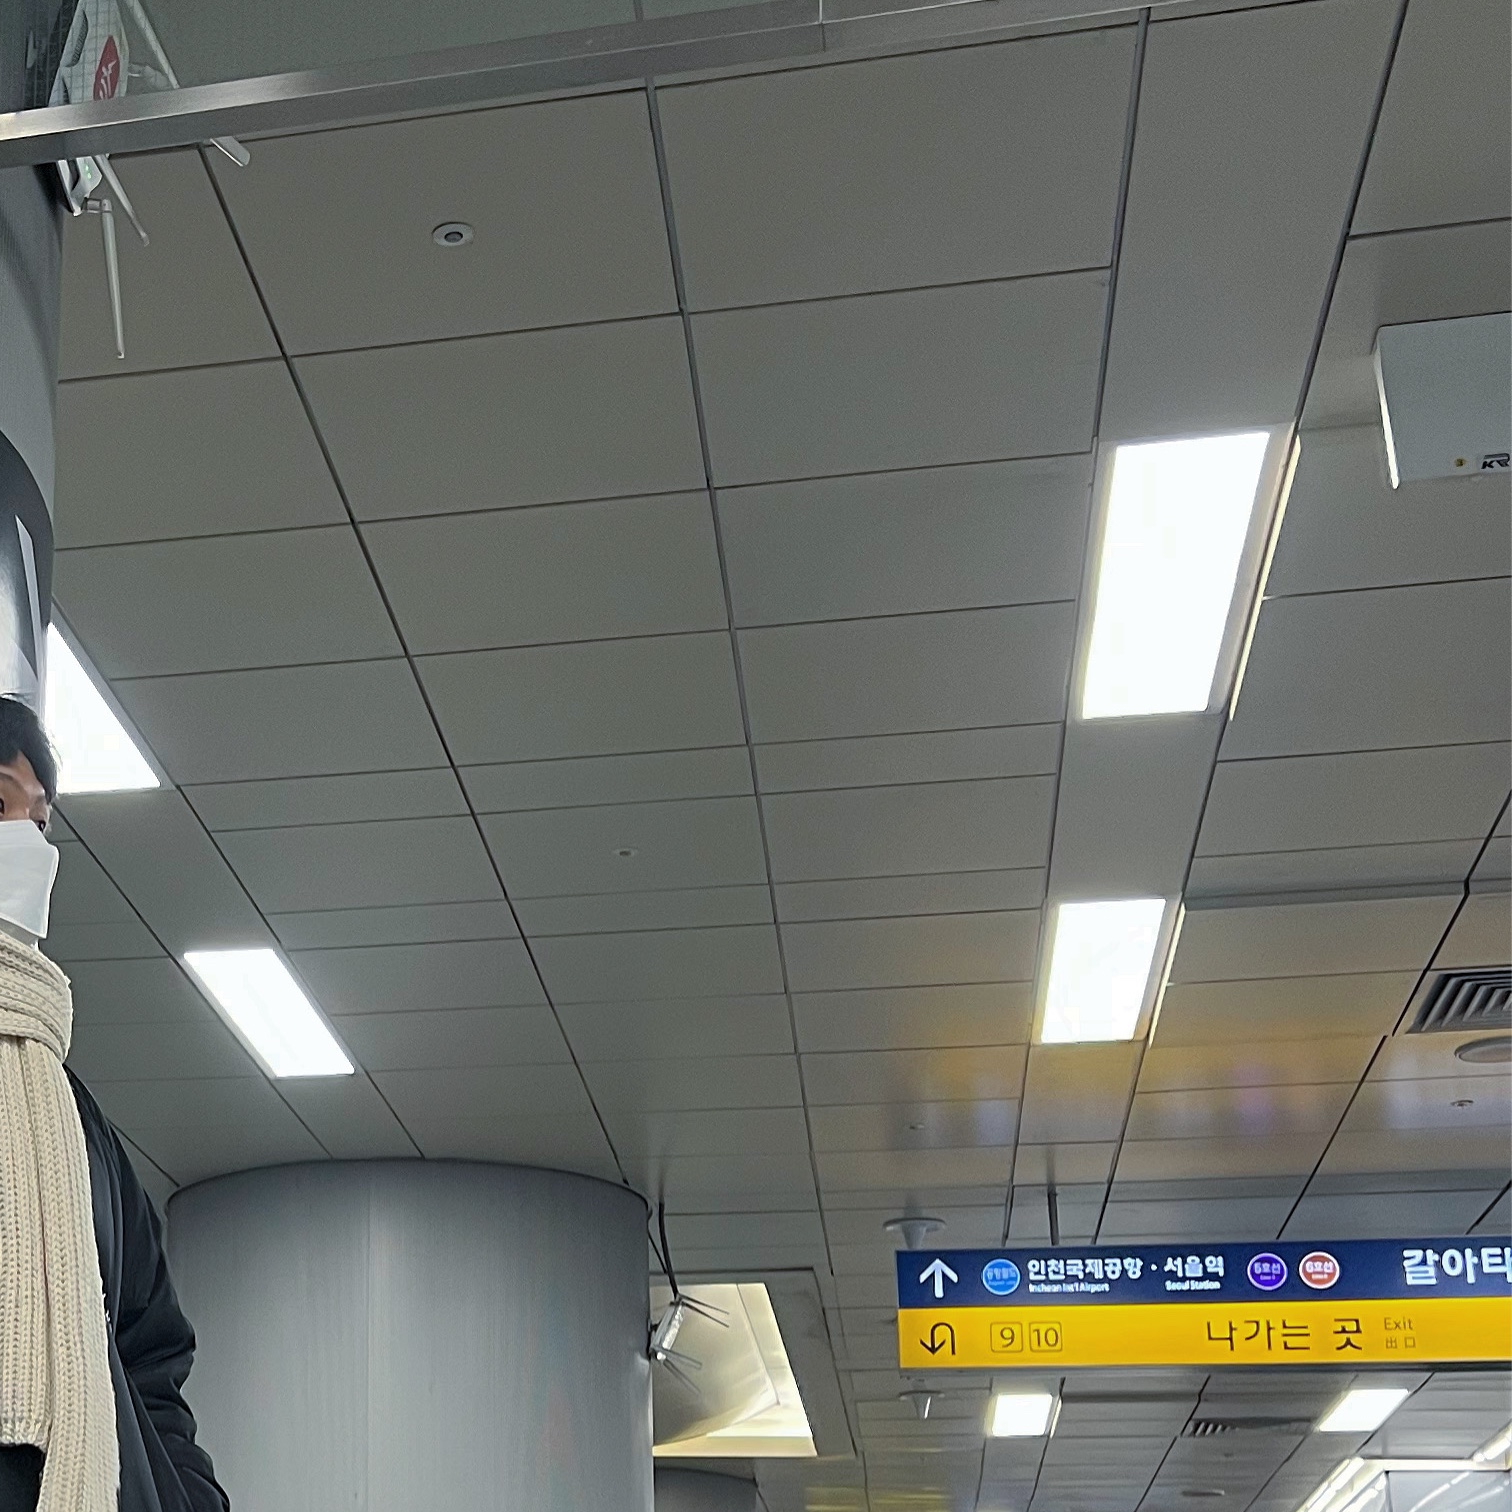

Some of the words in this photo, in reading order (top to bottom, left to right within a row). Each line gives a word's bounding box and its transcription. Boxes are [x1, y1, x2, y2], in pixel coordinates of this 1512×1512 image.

[1028, 1256, 1143, 1280] 인천국제공항
[1164, 1255, 1224, 1277] 서울역
[1080, 1281, 1110, 1294] Airport
[1165, 1281, 1190, 1291] Seoul
[1190, 1280, 1221, 1290] Station
[1384, 1316, 1414, 1331] Exit
[1000, 1327, 1015, 1348] 9
[1033, 1327, 1059, 1347] 10
[1207, 1319, 1310, 1351] 나가는
[1333, 1318, 1362, 1350] 곳
[1386, 1336, 1416, 1349] 出口
